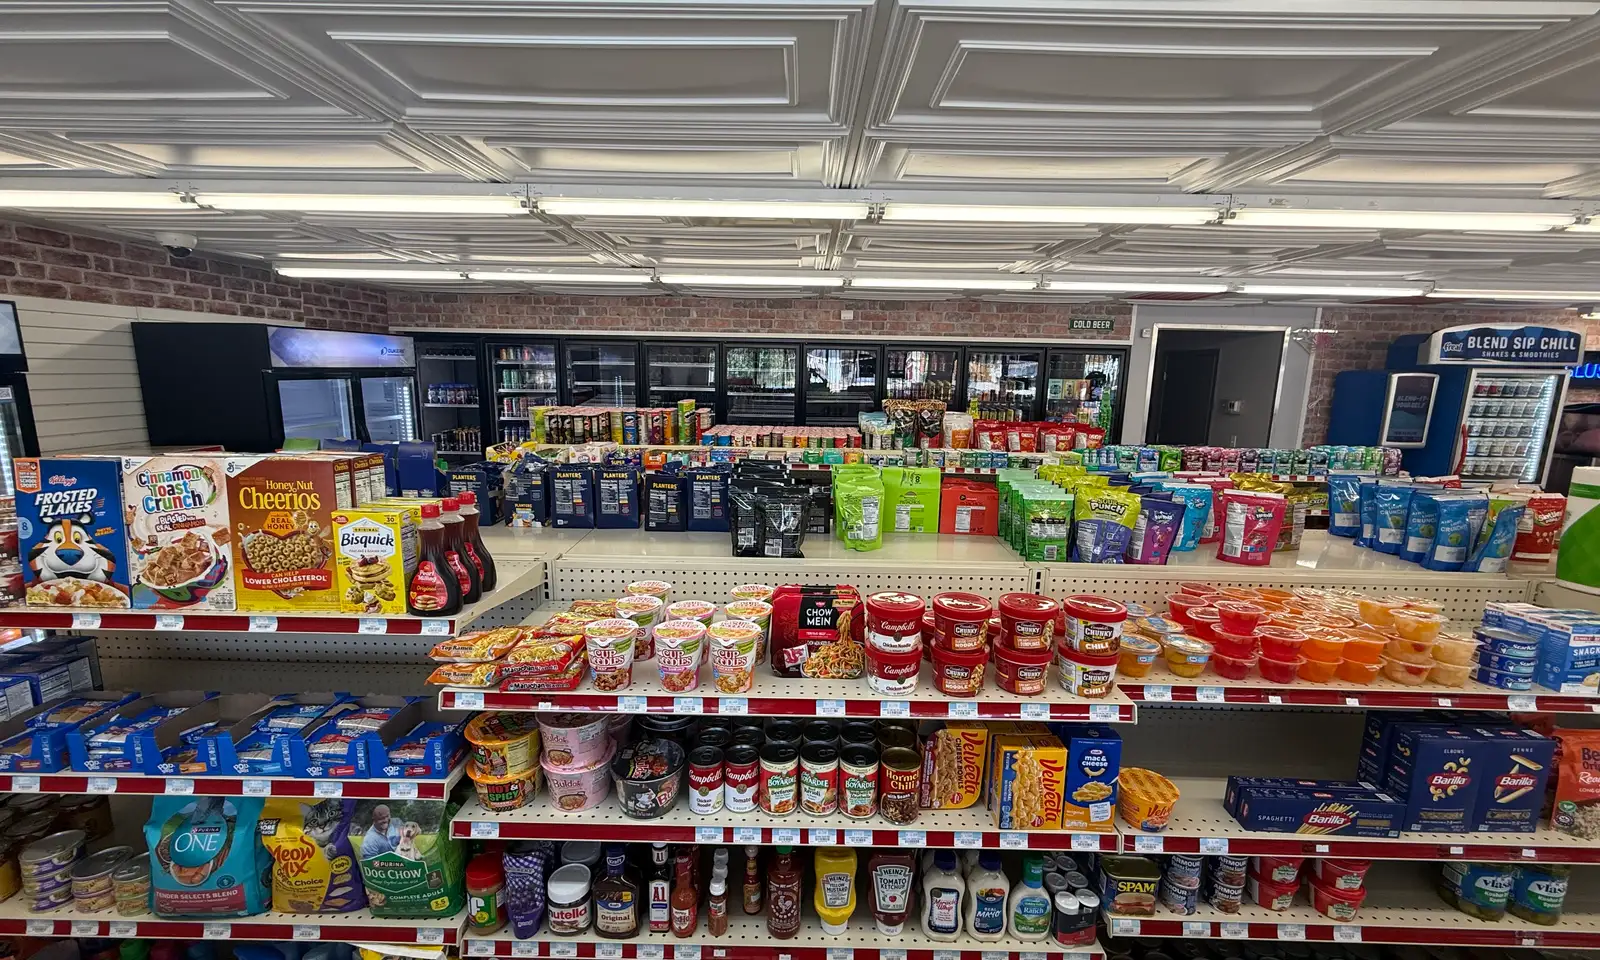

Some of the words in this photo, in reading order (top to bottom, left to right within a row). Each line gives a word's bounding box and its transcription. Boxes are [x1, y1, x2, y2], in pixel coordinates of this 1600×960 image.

[1073, 320, 1091, 328] COLD
[1092, 320, 1110, 329] BEER
[1467, 336, 1508, 350] BLEND
[1513, 336, 1536, 350] SIP
[1541, 337, 1576, 351] CHILL
[1518, 350, 1560, 359] SMOOTHIES
[48, 475, 78, 487] Kellogg's
[138, 468, 202, 486] Cinnamon
[452, 473, 477, 484] PLANTERS
[556, 472, 582, 480] PLANTERS
[603, 471, 629, 480] PLANTERS
[696, 474, 721, 482] PLANTERS
[150, 480, 192, 498] Toast
[266, 480, 294, 493] Honey
[296, 480, 314, 491] Nut
[652, 482, 678, 490] PLANTERS
[34, 488, 98, 506] FROSTED
[143, 489, 205, 514] Crunch
[239, 487, 321, 510] Cheerios
[39, 500, 92, 517] FLAKES
[514, 503, 533, 511] PLANTERS
[1090, 502, 1126, 516] PUNCH
[159, 512, 187, 525] BLASTED
[22, 520, 29, 531] 8
[156, 522, 173, 532] REAL
[173, 519, 206, 531] CINNAMON
[267, 523, 295, 531] HONEY
[340, 533, 395, 547] Bisquick
[245, 576, 271, 585] LOWER
[416, 584, 437, 595] Original
[806, 608, 833, 617] CHOW
[806, 617, 831, 626] MEIN
[881, 620, 915, 633] Campbell's
[1016, 626, 1041, 634] CHUNKY
[1085, 628, 1113, 638] CHUNKY
[1085, 642, 1109, 650] CHILI
[594, 649, 616, 660] CUP
[662, 649, 685, 660] CUP
[718, 649, 741, 660] CUP
[590, 654, 625, 667] NOODLES
[659, 655, 693, 667] NOODLES
[714, 654, 748, 667] NOODLES
[504, 666, 535, 677] Maruchan
[884, 662, 918, 677] Campbell's
[945, 669, 969, 677] CHUNKY
[1019, 670, 1041, 678] CHUNKY
[1083, 673, 1110, 682] CHUNKY
[514, 683, 545, 691] Maruchan
[1083, 687, 1106, 695] CHILI
[961, 731, 984, 795] Velveeta
[688, 769, 723, 784] Campbell's
[725, 768, 759, 782] Campbell's
[886, 769, 920, 782] Hormel
[1431, 775, 1468, 786] Barilla
[767, 776, 797, 787] BOYARDEE
[845, 778, 875, 789] BOYARDEE
[890, 780, 915, 791] Chili
[1499, 776, 1536, 787] Barilla
[487, 783, 510, 793] HOT
[510, 783, 519, 791] &
[1039, 759, 1064, 822] Velveeta
[488, 790, 518, 802] SPICY
[1258, 814, 1295, 823] SPAGHETTI
[1308, 815, 1348, 826] Barilla
[174, 832, 221, 853] ONE
[1171, 855, 1201, 867] ARMOUR
[1218, 855, 1247, 867] ARMOUR
[363, 869, 386, 879] DOG
[387, 868, 422, 880] CHOW
[883, 868, 904, 876] HEINZ
[294, 878, 325, 887] Choice
[828, 875, 849, 883] HEINZ
[879, 877, 907, 885] TOMATO
[422, 887, 446, 898] ADULT
[1117, 881, 1156, 894] SPAM
[1213, 883, 1243, 896] ARMOUR
[156, 891, 179, 899] TENDER
[212, 889, 239, 898] BLEND
[434, 898, 447, 906] 3.5
[548, 905, 588, 921] nutella
[976, 910, 1002, 918] MAYO
[1023, 906, 1044, 914] Ranch
[601, 914, 630, 923] Original
